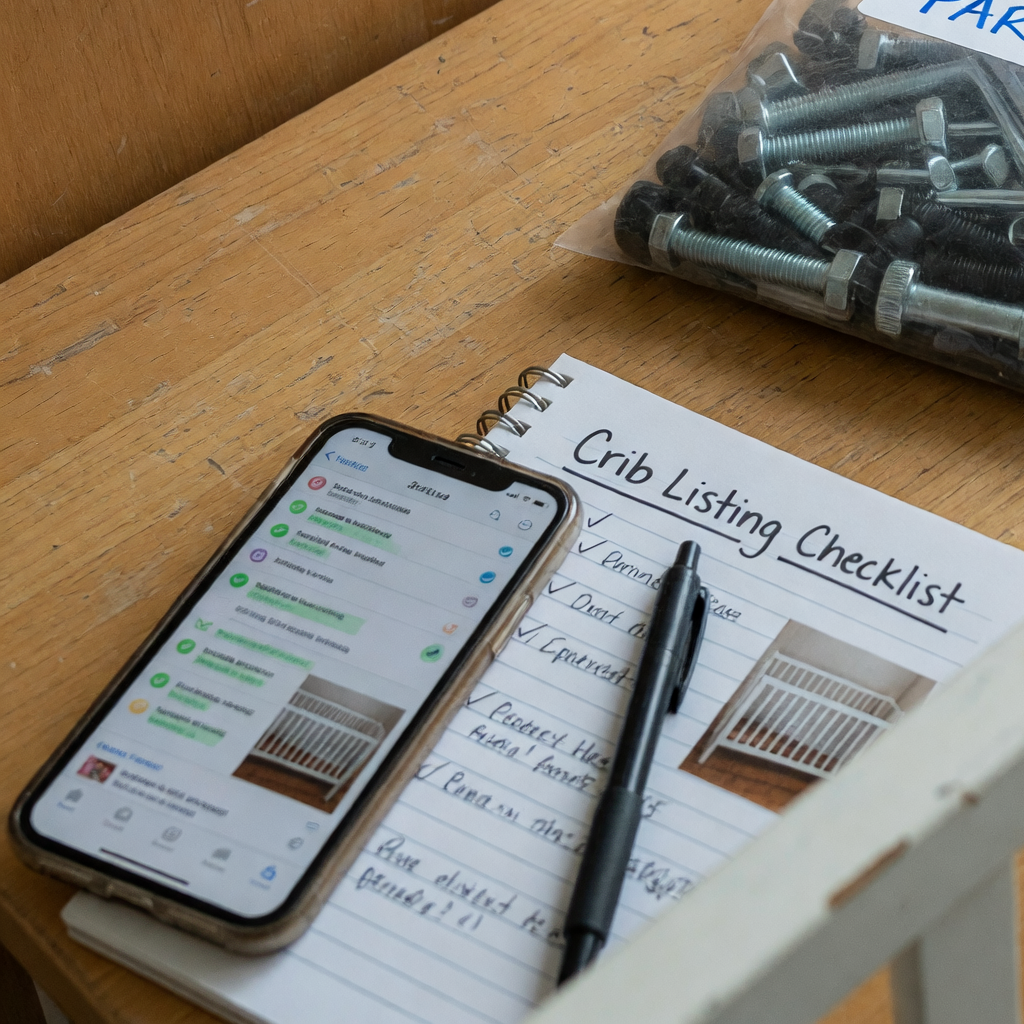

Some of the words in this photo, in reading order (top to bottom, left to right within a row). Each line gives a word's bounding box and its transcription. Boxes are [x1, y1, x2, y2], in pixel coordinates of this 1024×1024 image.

[571, 428, 653, 486] Crib
[662, 468, 783, 559] Listing
[794, 524, 966, 616] Checklist
